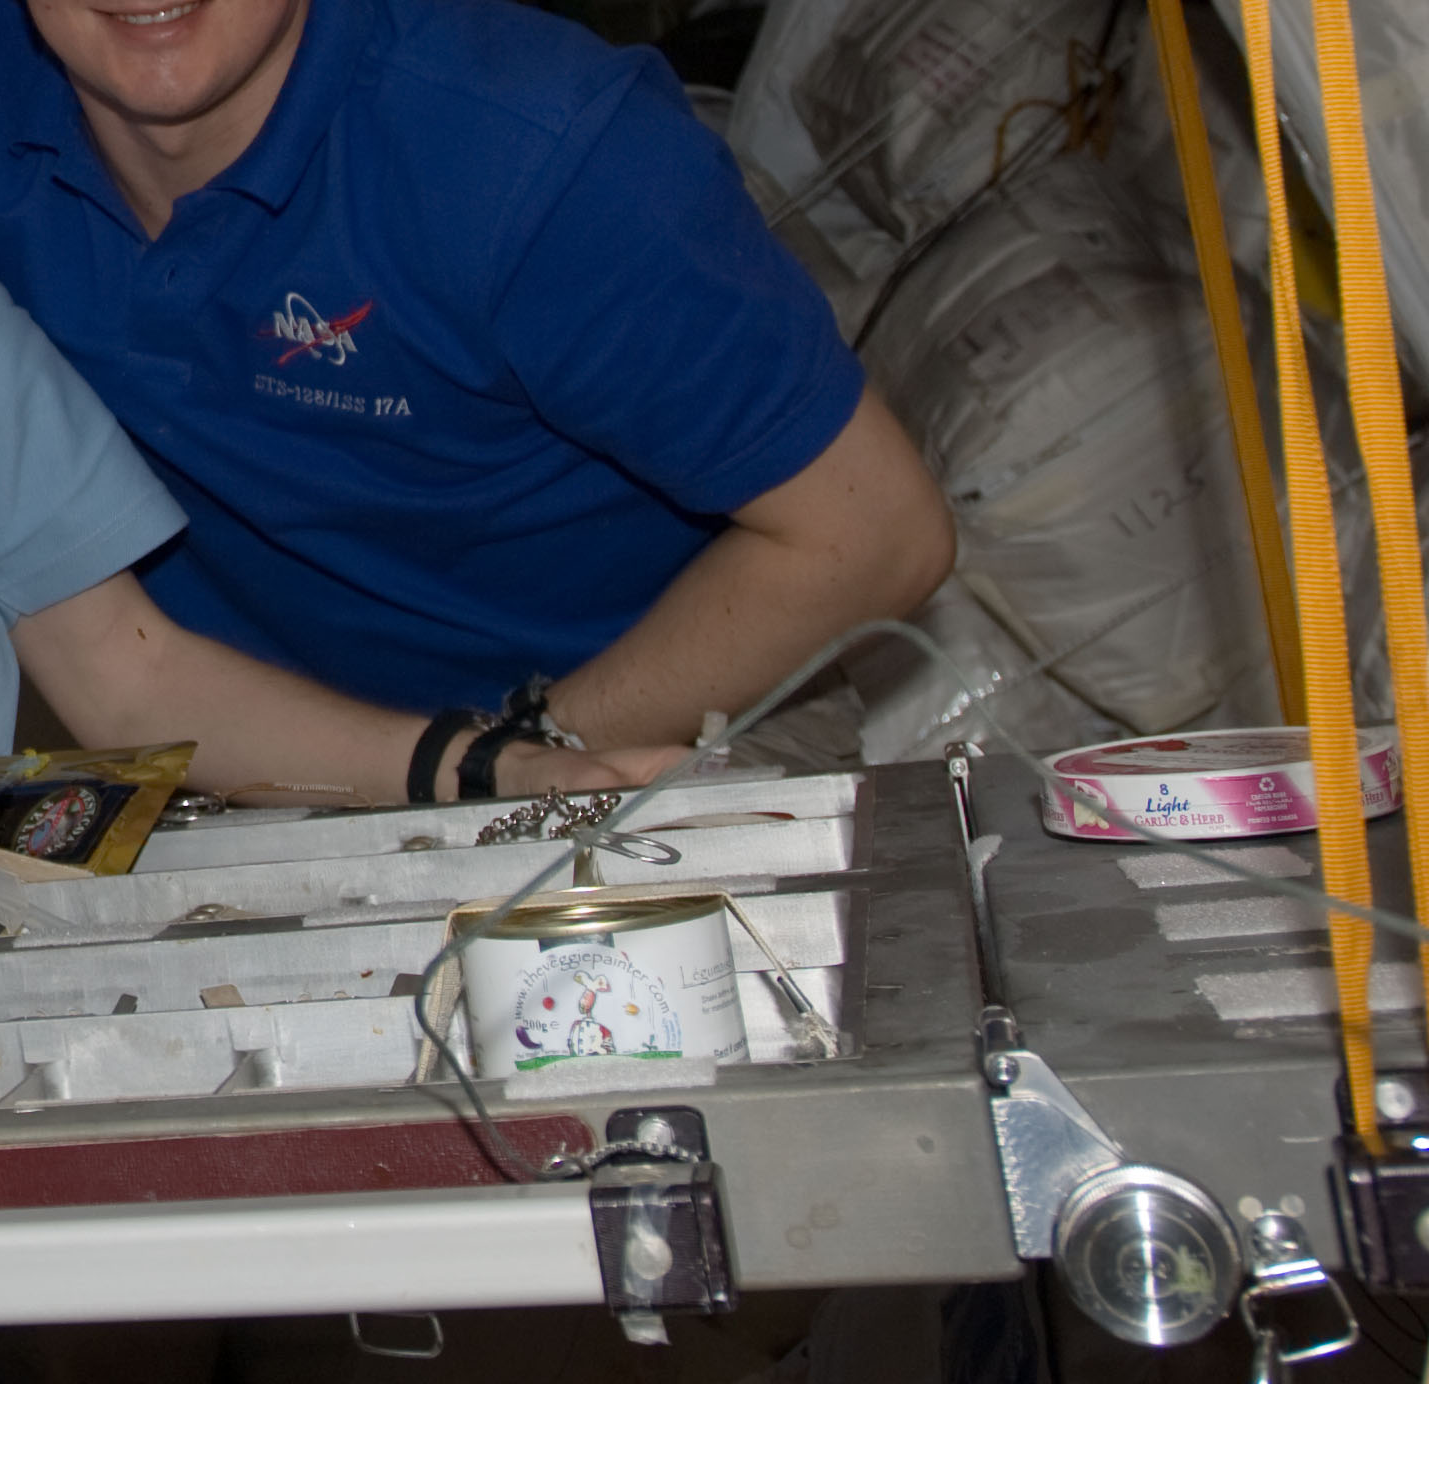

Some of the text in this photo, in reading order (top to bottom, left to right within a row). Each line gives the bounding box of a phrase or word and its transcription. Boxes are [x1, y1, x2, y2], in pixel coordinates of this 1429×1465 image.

[374, 395, 413, 416] 17A
[1159, 783, 1170, 797] 8
[1145, 797, 1191, 821] Light
[1134, 812, 1226, 829] GARLIC & HERB
[515, 950, 671, 1021] www.theveggiepainter.com
